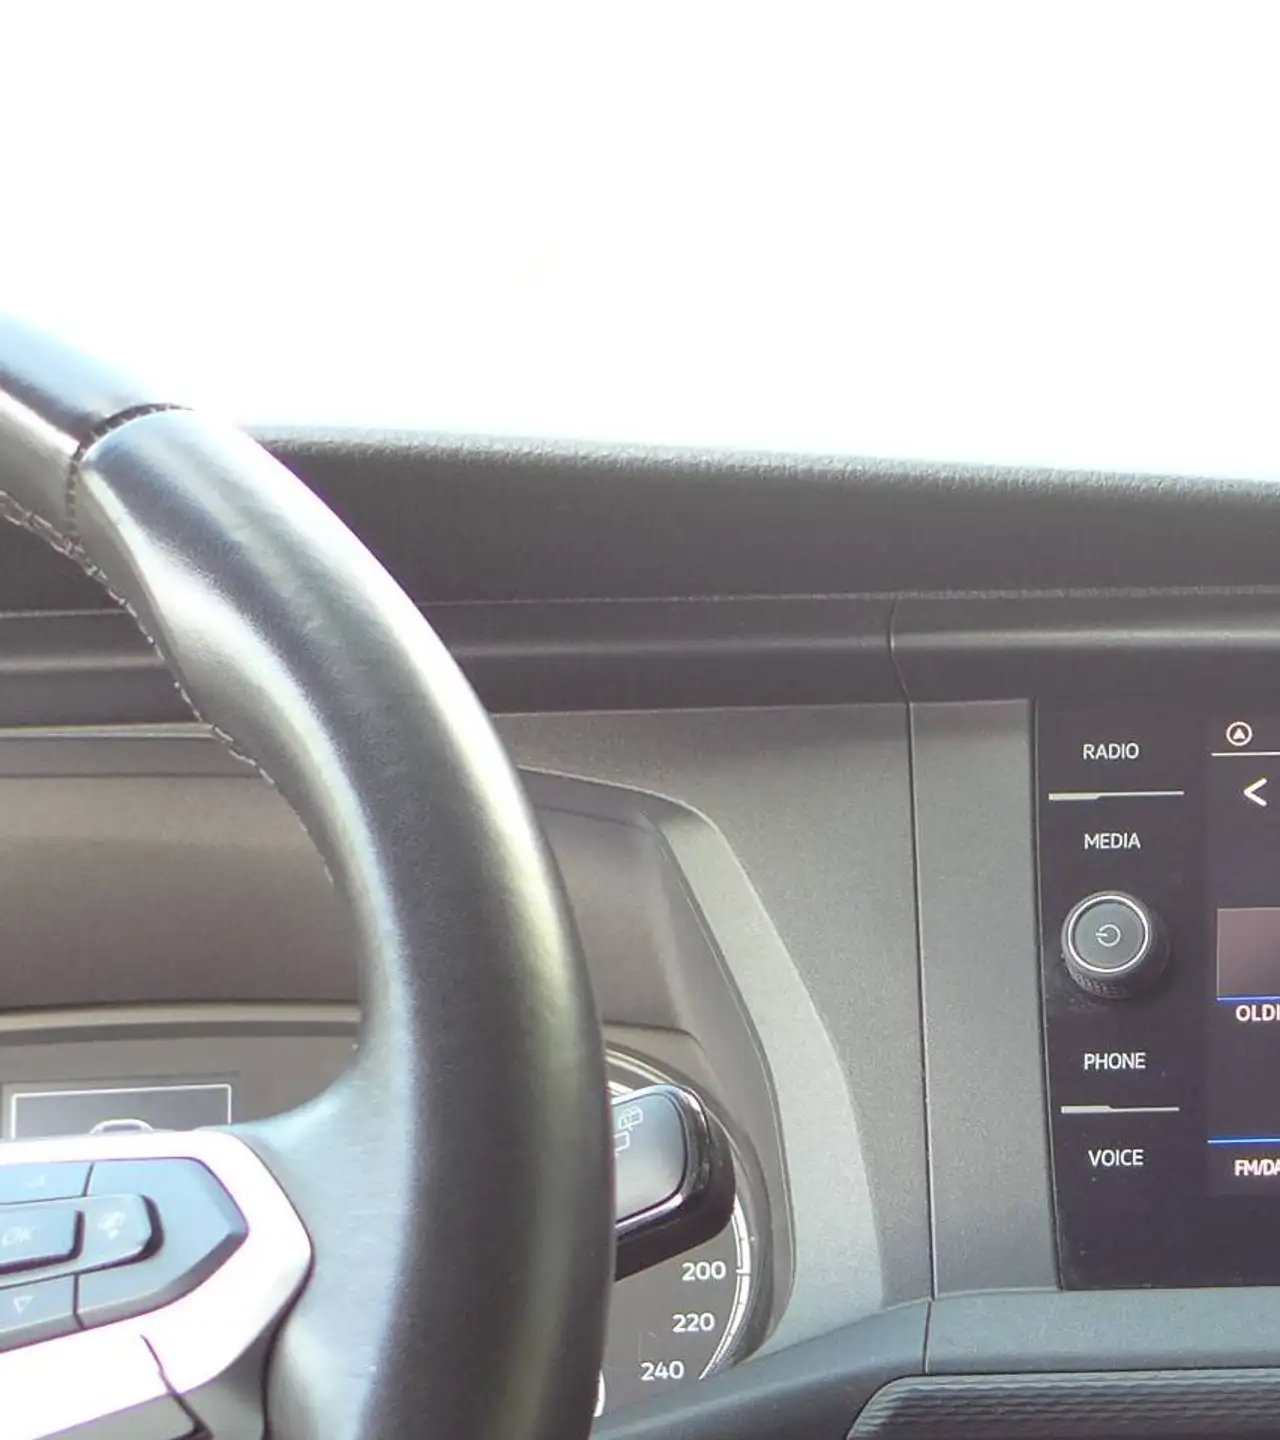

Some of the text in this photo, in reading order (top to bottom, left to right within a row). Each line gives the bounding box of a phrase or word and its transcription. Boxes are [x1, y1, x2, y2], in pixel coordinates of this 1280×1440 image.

[1082, 743, 1139, 760] RADIO
[1084, 833, 1141, 849] MEDIA
[1084, 1052, 1146, 1070] PHONE
[1088, 1149, 1144, 1167] VOICE
[2, 1226, 35, 1246] OK
[681, 1261, 727, 1281] 200
[672, 1313, 716, 1334] 220
[640, 1361, 685, 1382] 240
